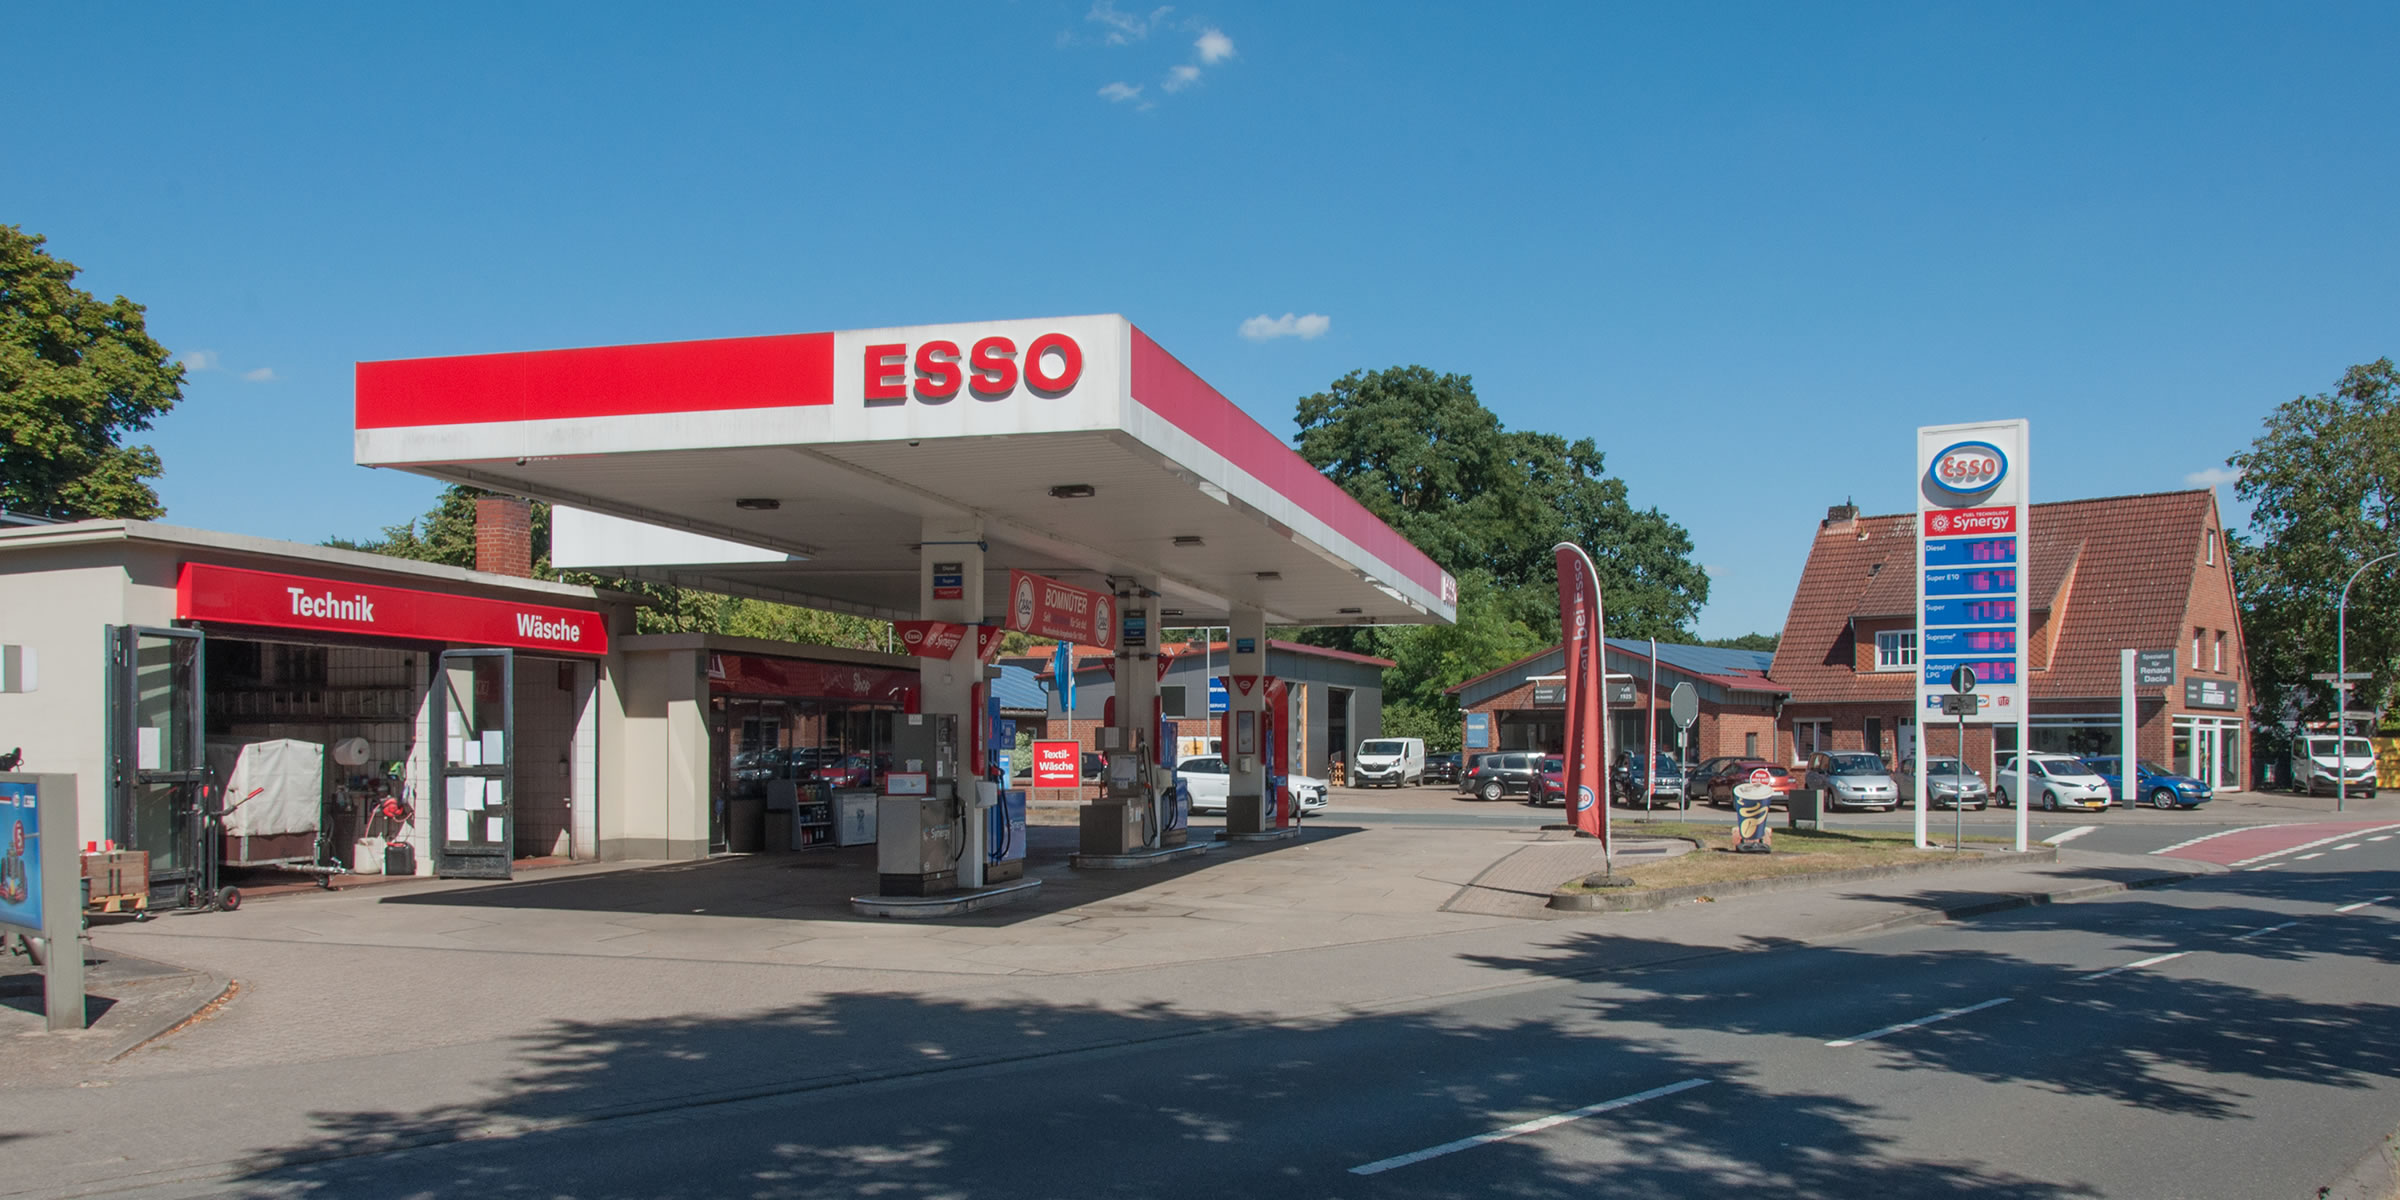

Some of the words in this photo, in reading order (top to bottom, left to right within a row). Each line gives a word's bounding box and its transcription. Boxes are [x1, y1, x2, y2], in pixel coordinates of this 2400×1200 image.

[863, 333, 1083, 400] ESSO
[1943, 456, 1995, 478] Esso
[1953, 516, 2009, 531] Synergy
[1925, 544, 1946, 552] Diesel
[1573, 560, 1584, 603] Esso
[1926, 574, 1945, 582] Super
[287, 587, 374, 622] Technik
[516, 613, 580, 642] Wäsche
[1573, 609, 1588, 640] bei
[980, 634, 986, 645] 8
[853, 673, 871, 695] Shop
[1043, 750, 1070, 759] Textil-
[1040, 762, 1074, 771] Wäsche
